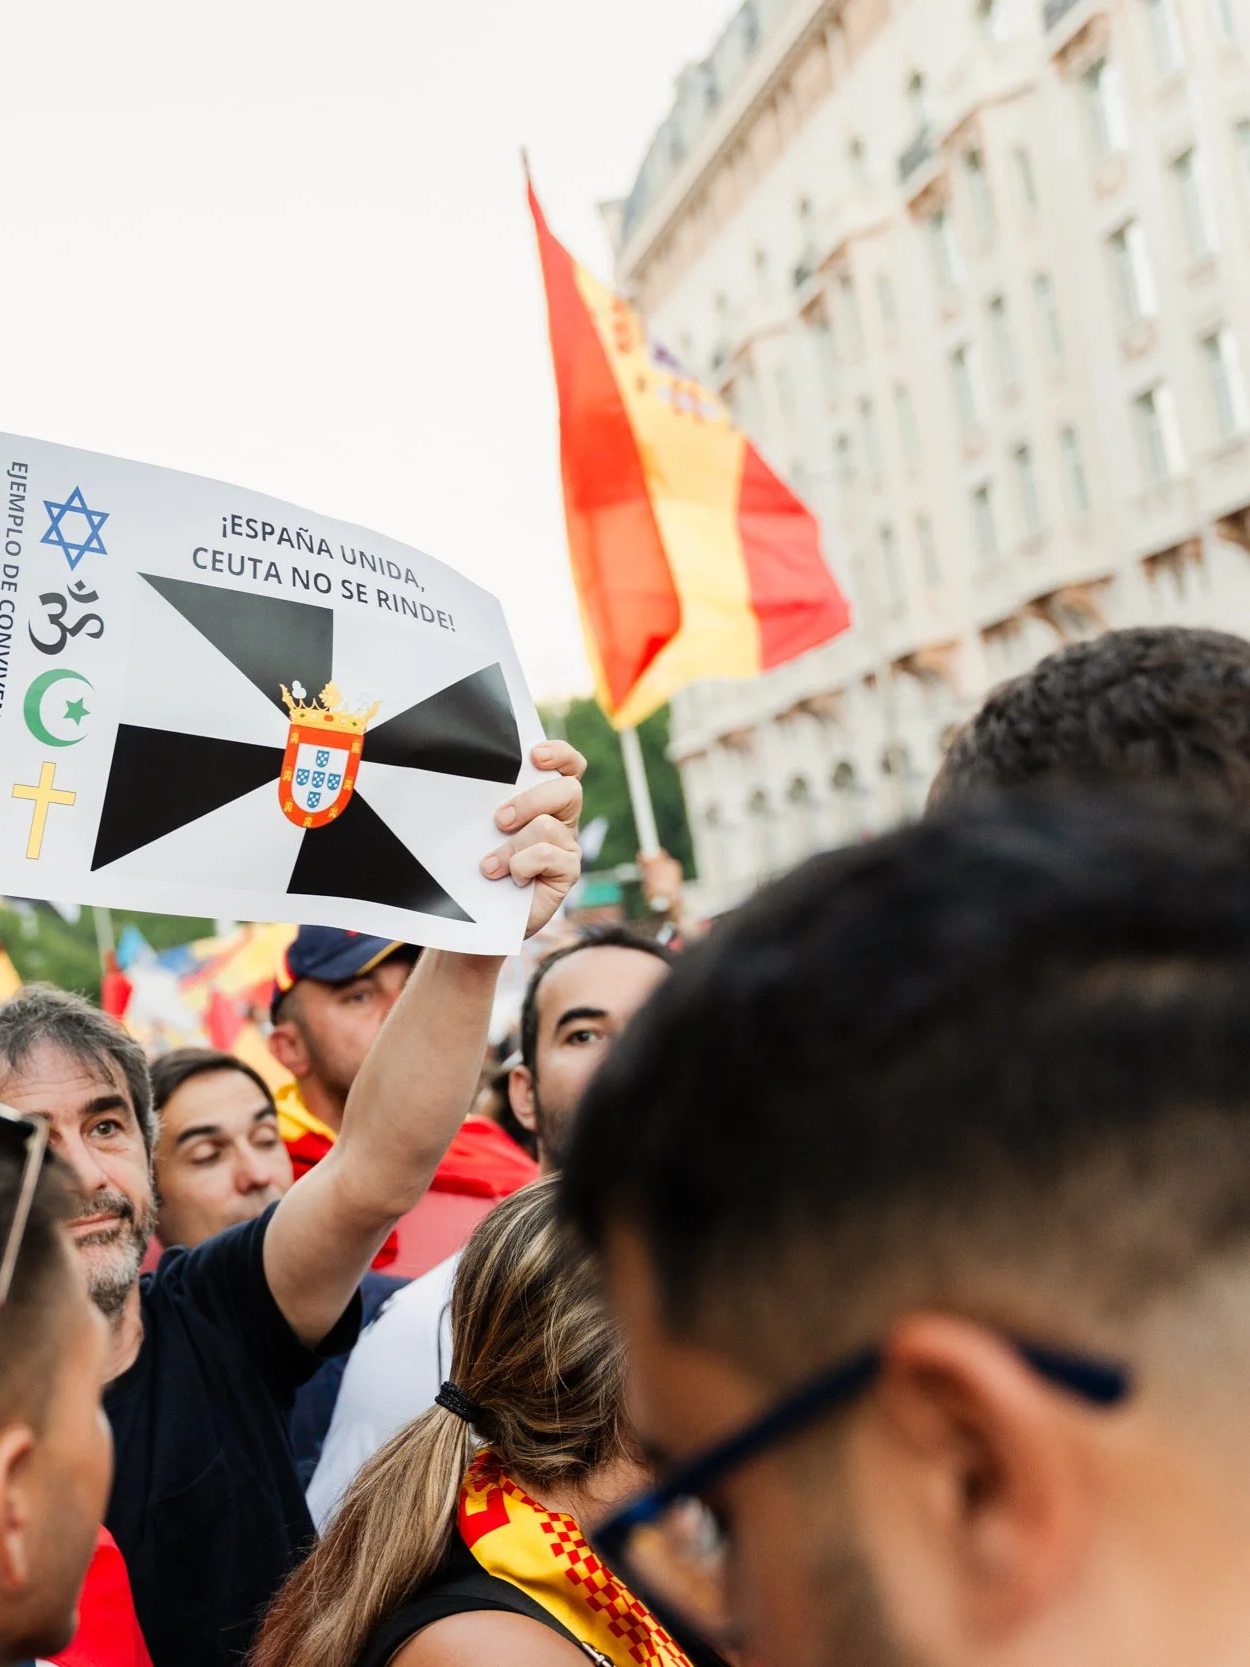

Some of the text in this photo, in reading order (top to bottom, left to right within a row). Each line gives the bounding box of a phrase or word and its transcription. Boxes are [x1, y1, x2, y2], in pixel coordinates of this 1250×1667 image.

[5, 461, 29, 557] EJEMPLO
[1, 563, 20, 593] DE
[192, 546, 457, 633] CEUTA NO SE RINDE!
[221, 513, 426, 593] ¡ESPAÑA UNIDA,
